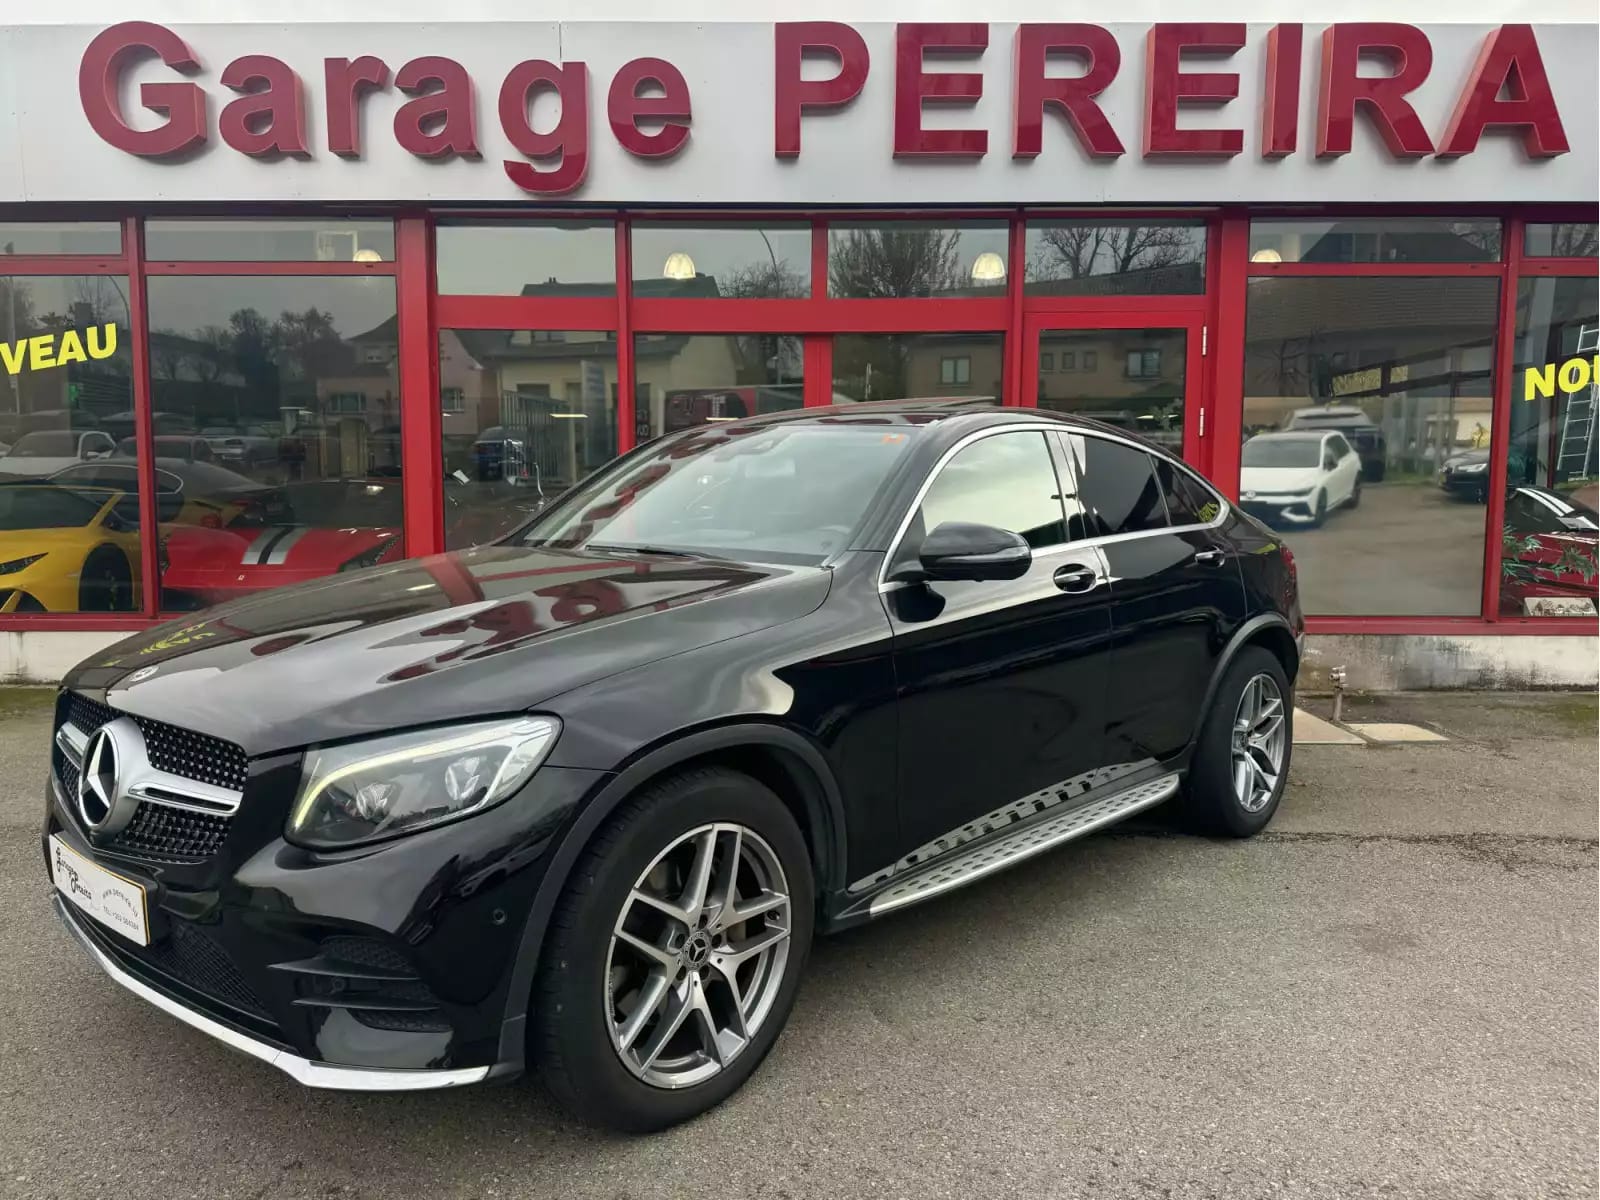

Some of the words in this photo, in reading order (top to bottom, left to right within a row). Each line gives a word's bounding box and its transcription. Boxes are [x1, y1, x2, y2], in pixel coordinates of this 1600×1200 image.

[79, 21, 693, 195] Garage
[775, 22, 1570, 159] PEREIRA
[1524, 355, 1599, 401] NO
